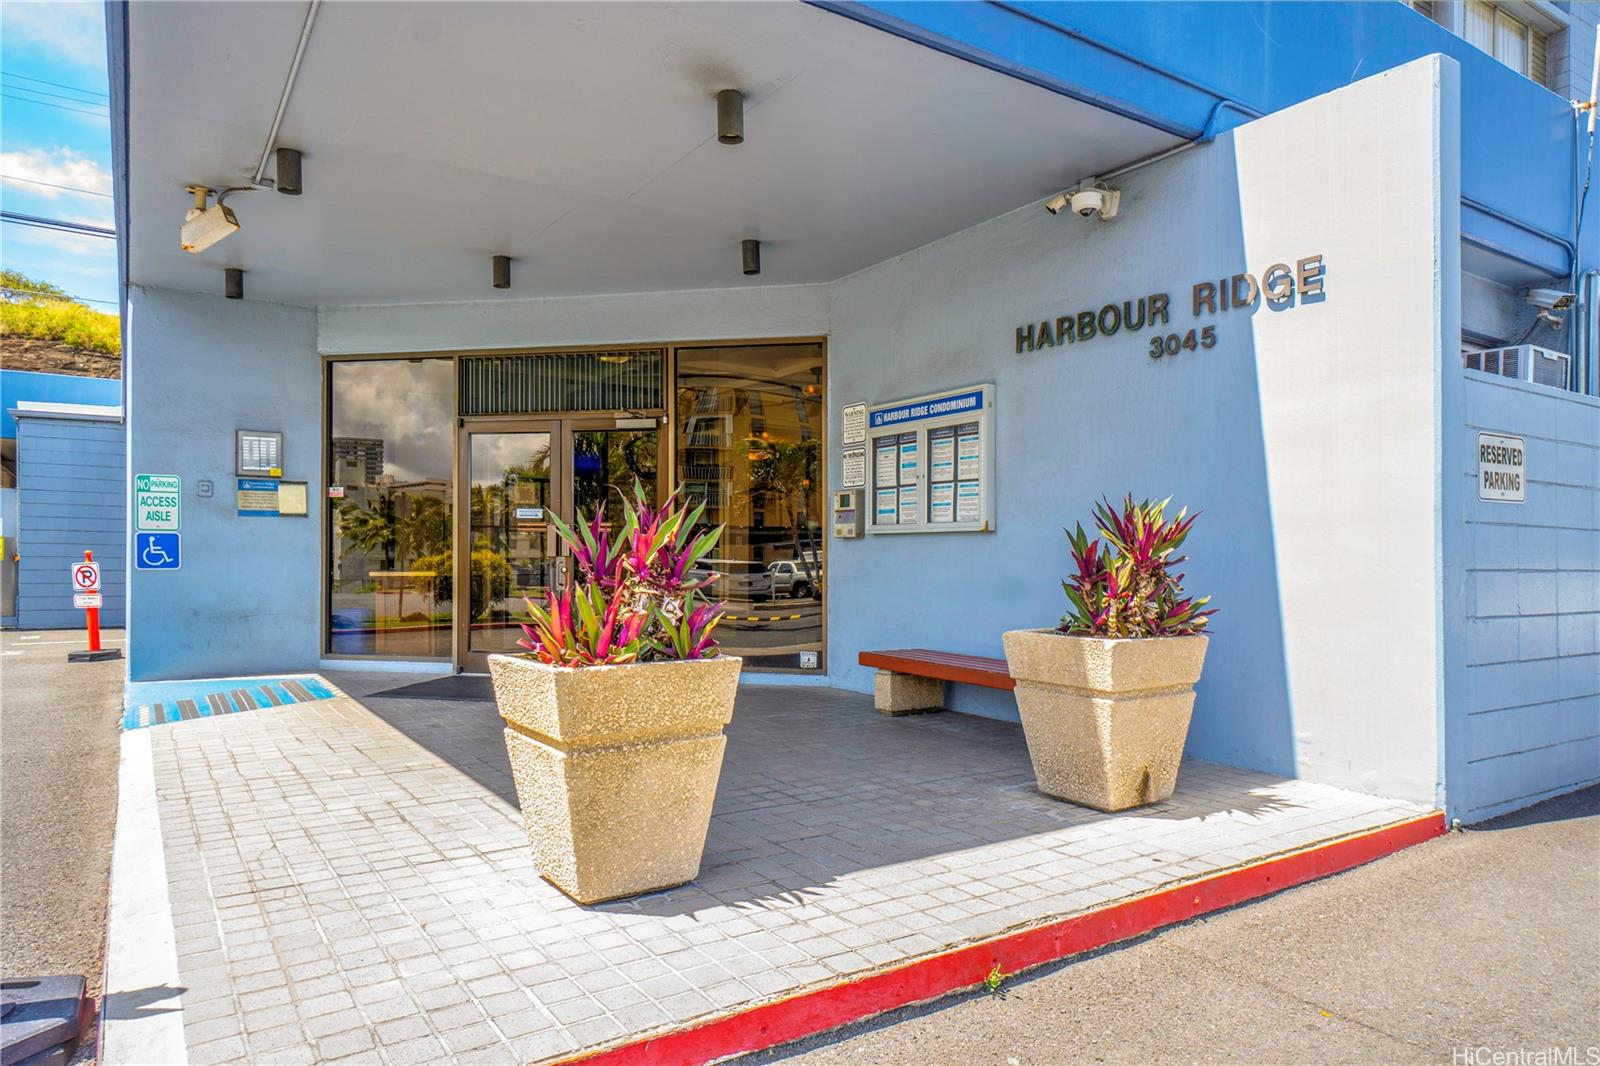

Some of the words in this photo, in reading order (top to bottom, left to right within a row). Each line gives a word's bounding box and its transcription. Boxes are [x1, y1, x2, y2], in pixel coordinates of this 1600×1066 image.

[1015, 293, 1169, 353] HARBOUR
[1192, 254, 1324, 317] RIDGE
[1149, 325, 1216, 359] 3045
[845, 409, 865, 417] WARNING
[883, 409, 910, 422] HARBOUR
[911, 406, 928, 418] RIDGE
[929, 396, 977, 415] CONDOMINIUM
[1480, 444, 1523, 467] RESERVED
[137, 478, 149, 490] NO
[150, 480, 178, 489] PARKING
[1484, 470, 1521, 492] PARKING
[140, 496, 177, 508] ACCESS
[146, 510, 171, 521] AISLE
